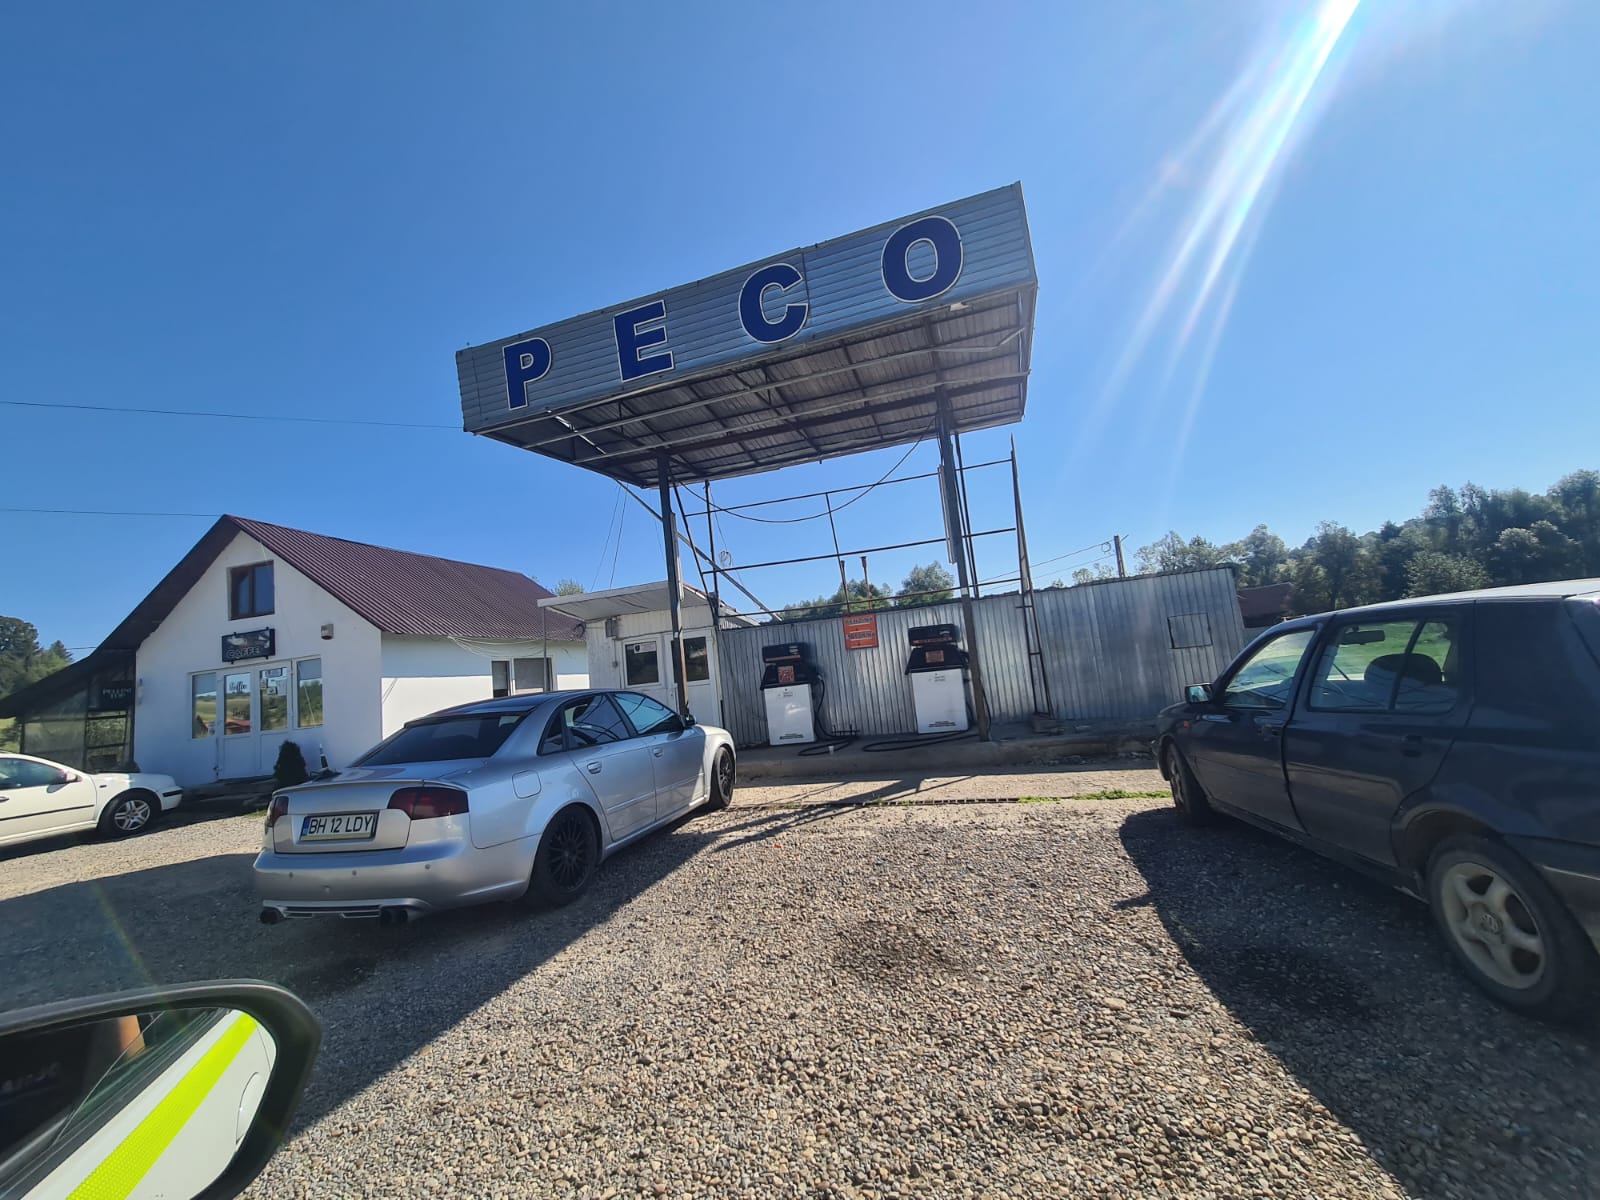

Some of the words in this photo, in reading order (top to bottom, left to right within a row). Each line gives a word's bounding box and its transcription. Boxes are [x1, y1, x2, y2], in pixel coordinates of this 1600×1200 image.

[502, 214, 964, 411] PECO
[309, 818, 327, 834] BH
[331, 817, 342, 833] 12
[345, 815, 373, 832] LDY
